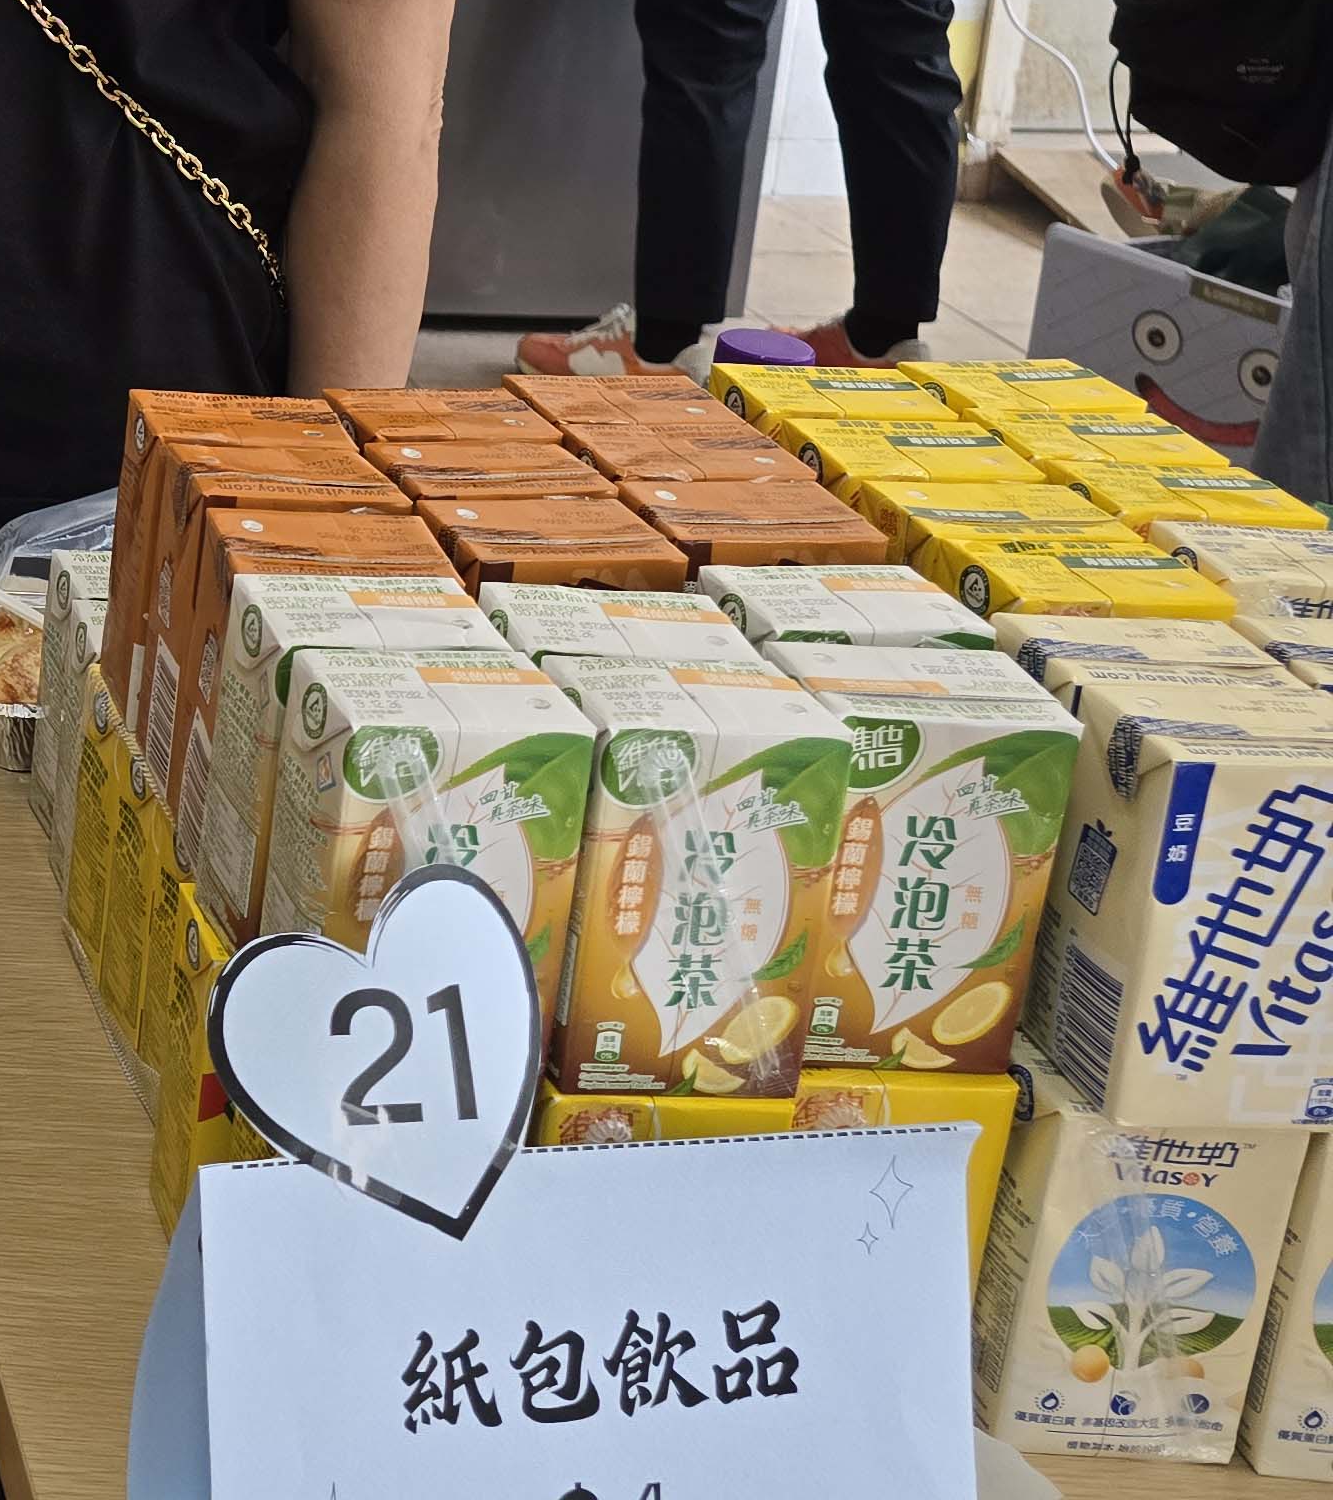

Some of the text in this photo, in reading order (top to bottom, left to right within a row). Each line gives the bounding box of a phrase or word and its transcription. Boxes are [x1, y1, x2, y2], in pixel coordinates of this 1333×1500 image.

[615, 833, 653, 936] 錫蘭檸檬
[832, 817, 874, 915] 錫蘭檸檬
[880, 815, 957, 991] 冷泡茶
[1166, 813, 1196, 863] 豆奶
[663, 829, 737, 1009] 冷泡茶
[328, 983, 479, 1127] 21
[401, 1299, 801, 1434] 紙包飲品
